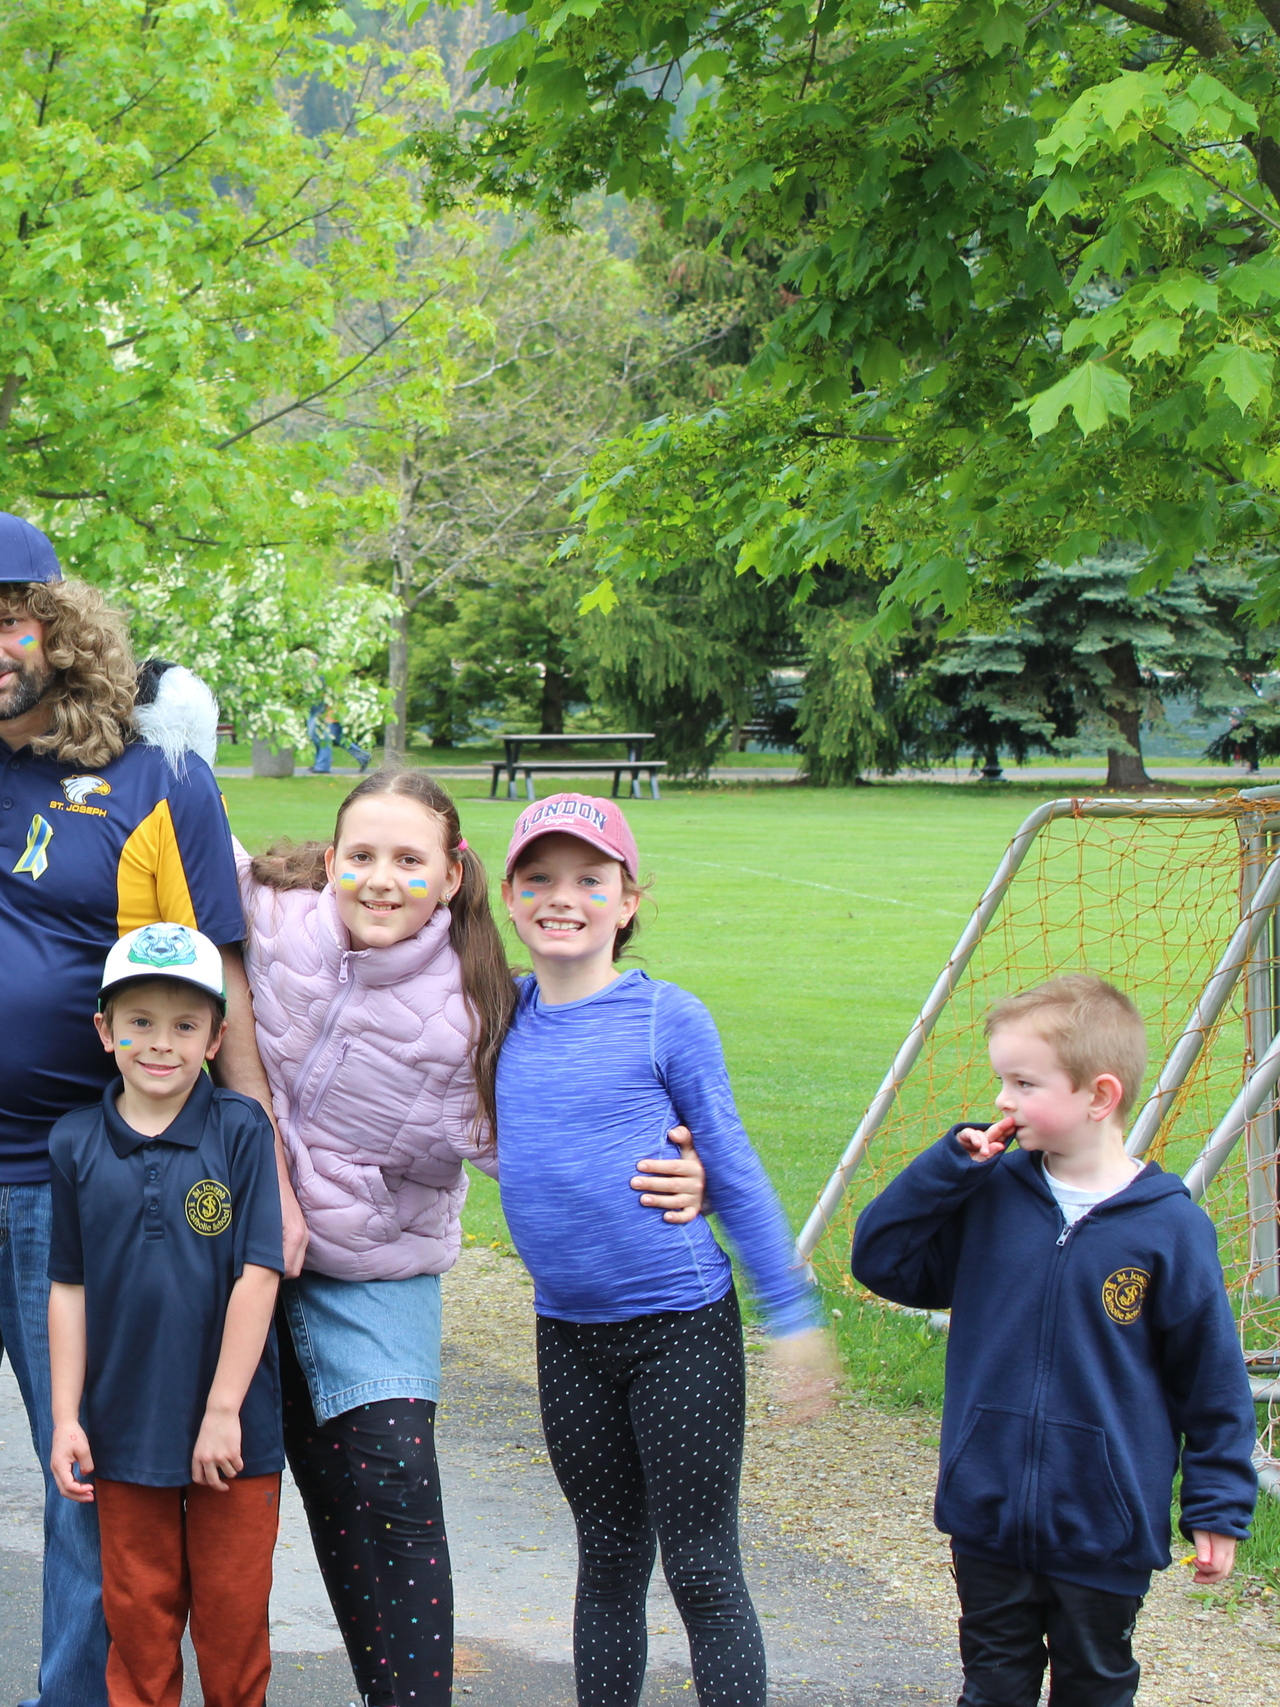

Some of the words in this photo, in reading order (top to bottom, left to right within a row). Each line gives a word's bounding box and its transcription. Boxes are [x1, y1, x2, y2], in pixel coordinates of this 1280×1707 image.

[49, 800, 64, 811] ST.
[66, 804, 108, 818] JOSEPH
[520, 800, 608, 838] LONDON
[192, 1188, 203, 1199] St.
[202, 1183, 227, 1200] Joseph
[188, 1208, 212, 1232] Catholic
[212, 1209, 230, 1231] School
[1105, 1289, 1125, 1320] Catholic
